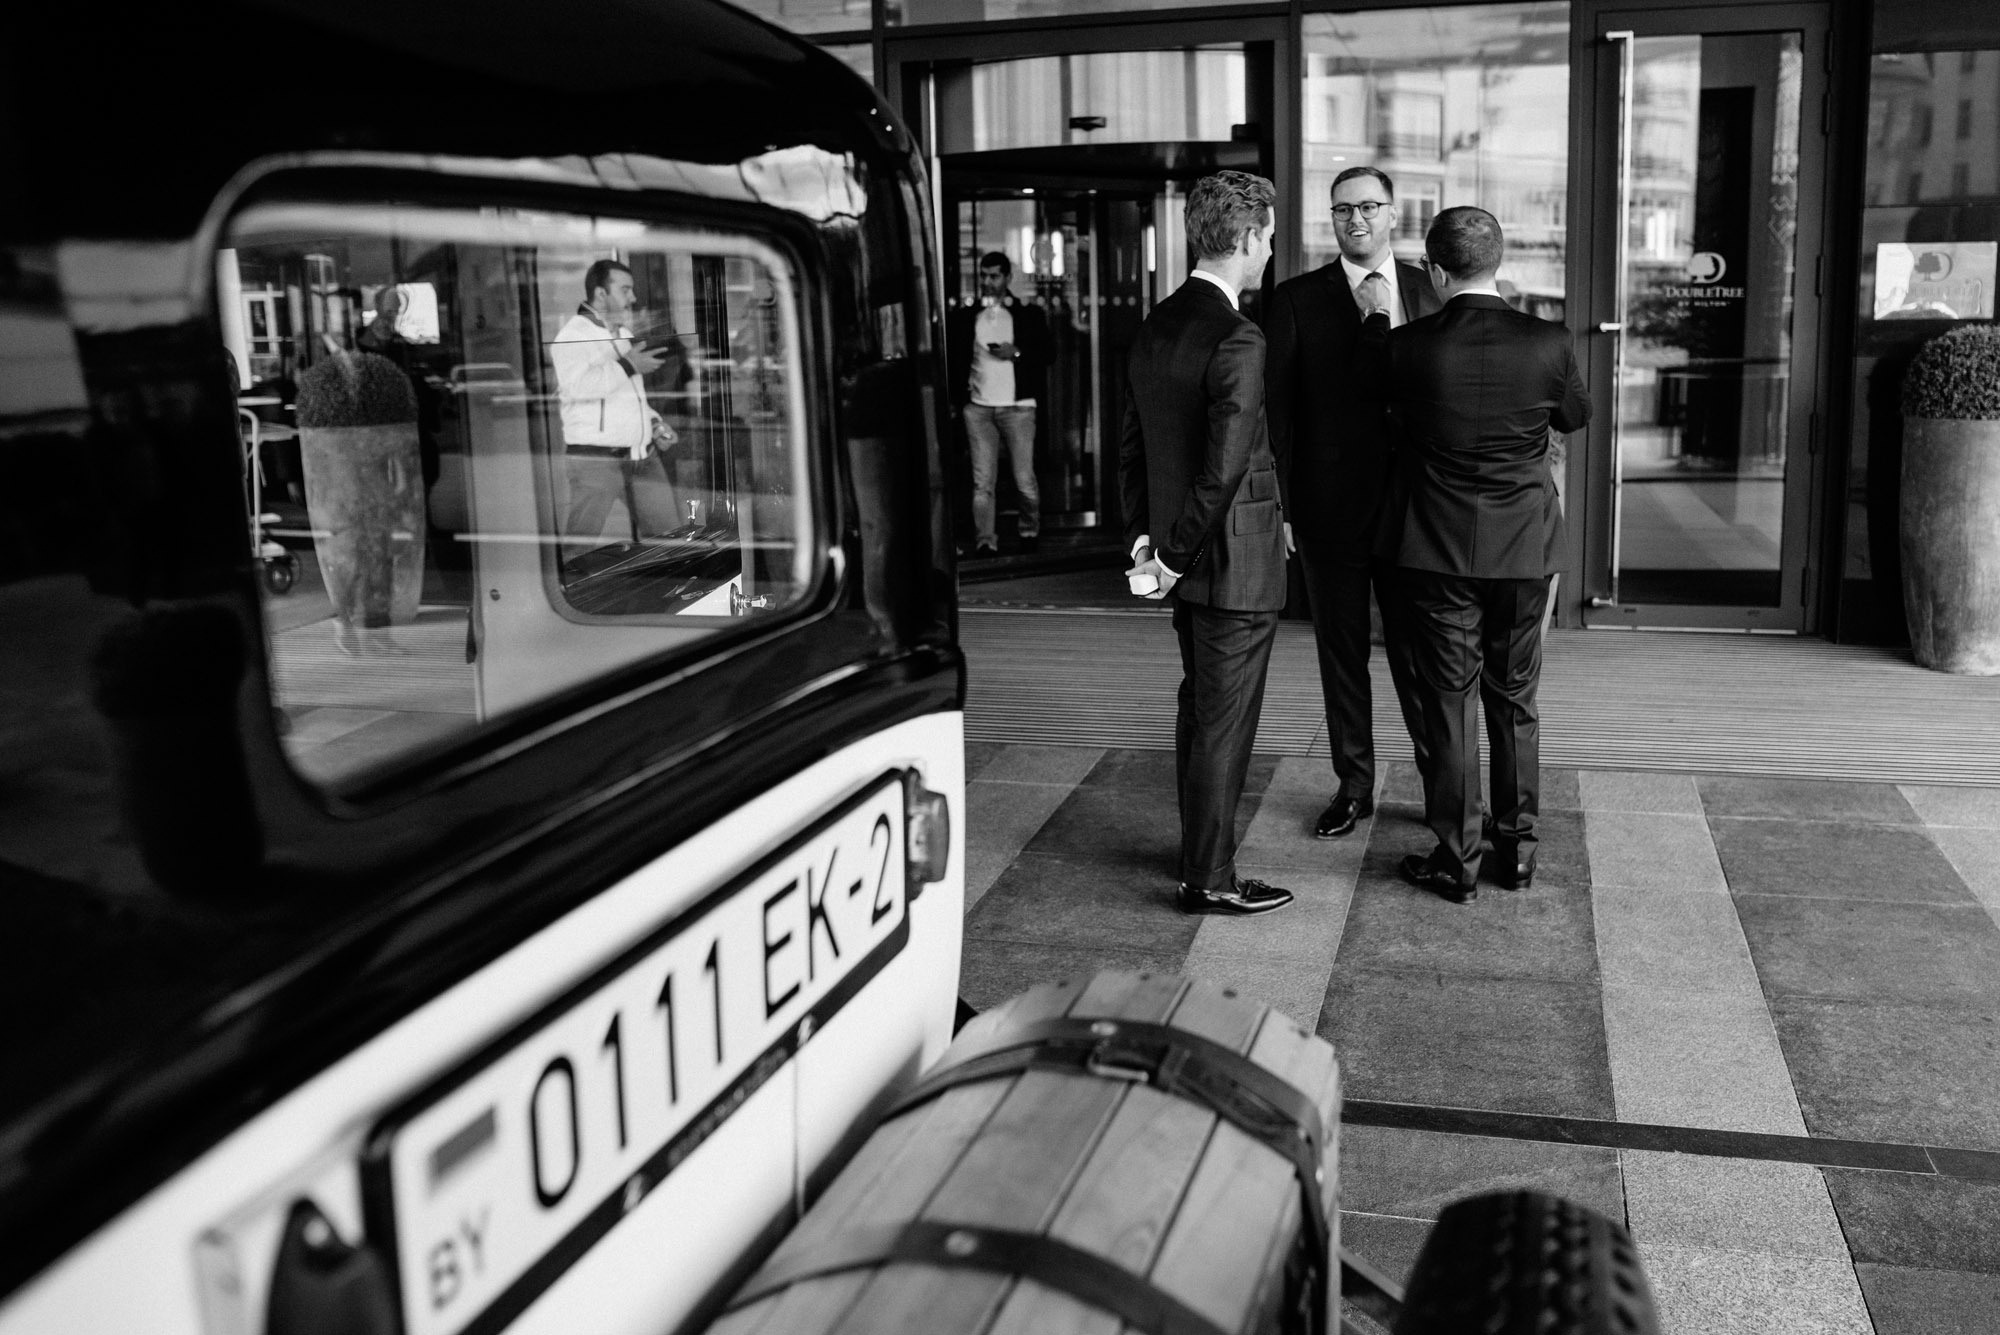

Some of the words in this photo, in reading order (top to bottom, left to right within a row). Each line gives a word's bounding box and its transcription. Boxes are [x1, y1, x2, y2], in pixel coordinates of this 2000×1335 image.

[1678, 300, 1690, 308] BY
[1694, 300, 1728, 308] HILTON
[530, 937, 723, 1210] 0111
[762, 812, 893, 1021] EK-2
[427, 1208, 491, 1312] BY
